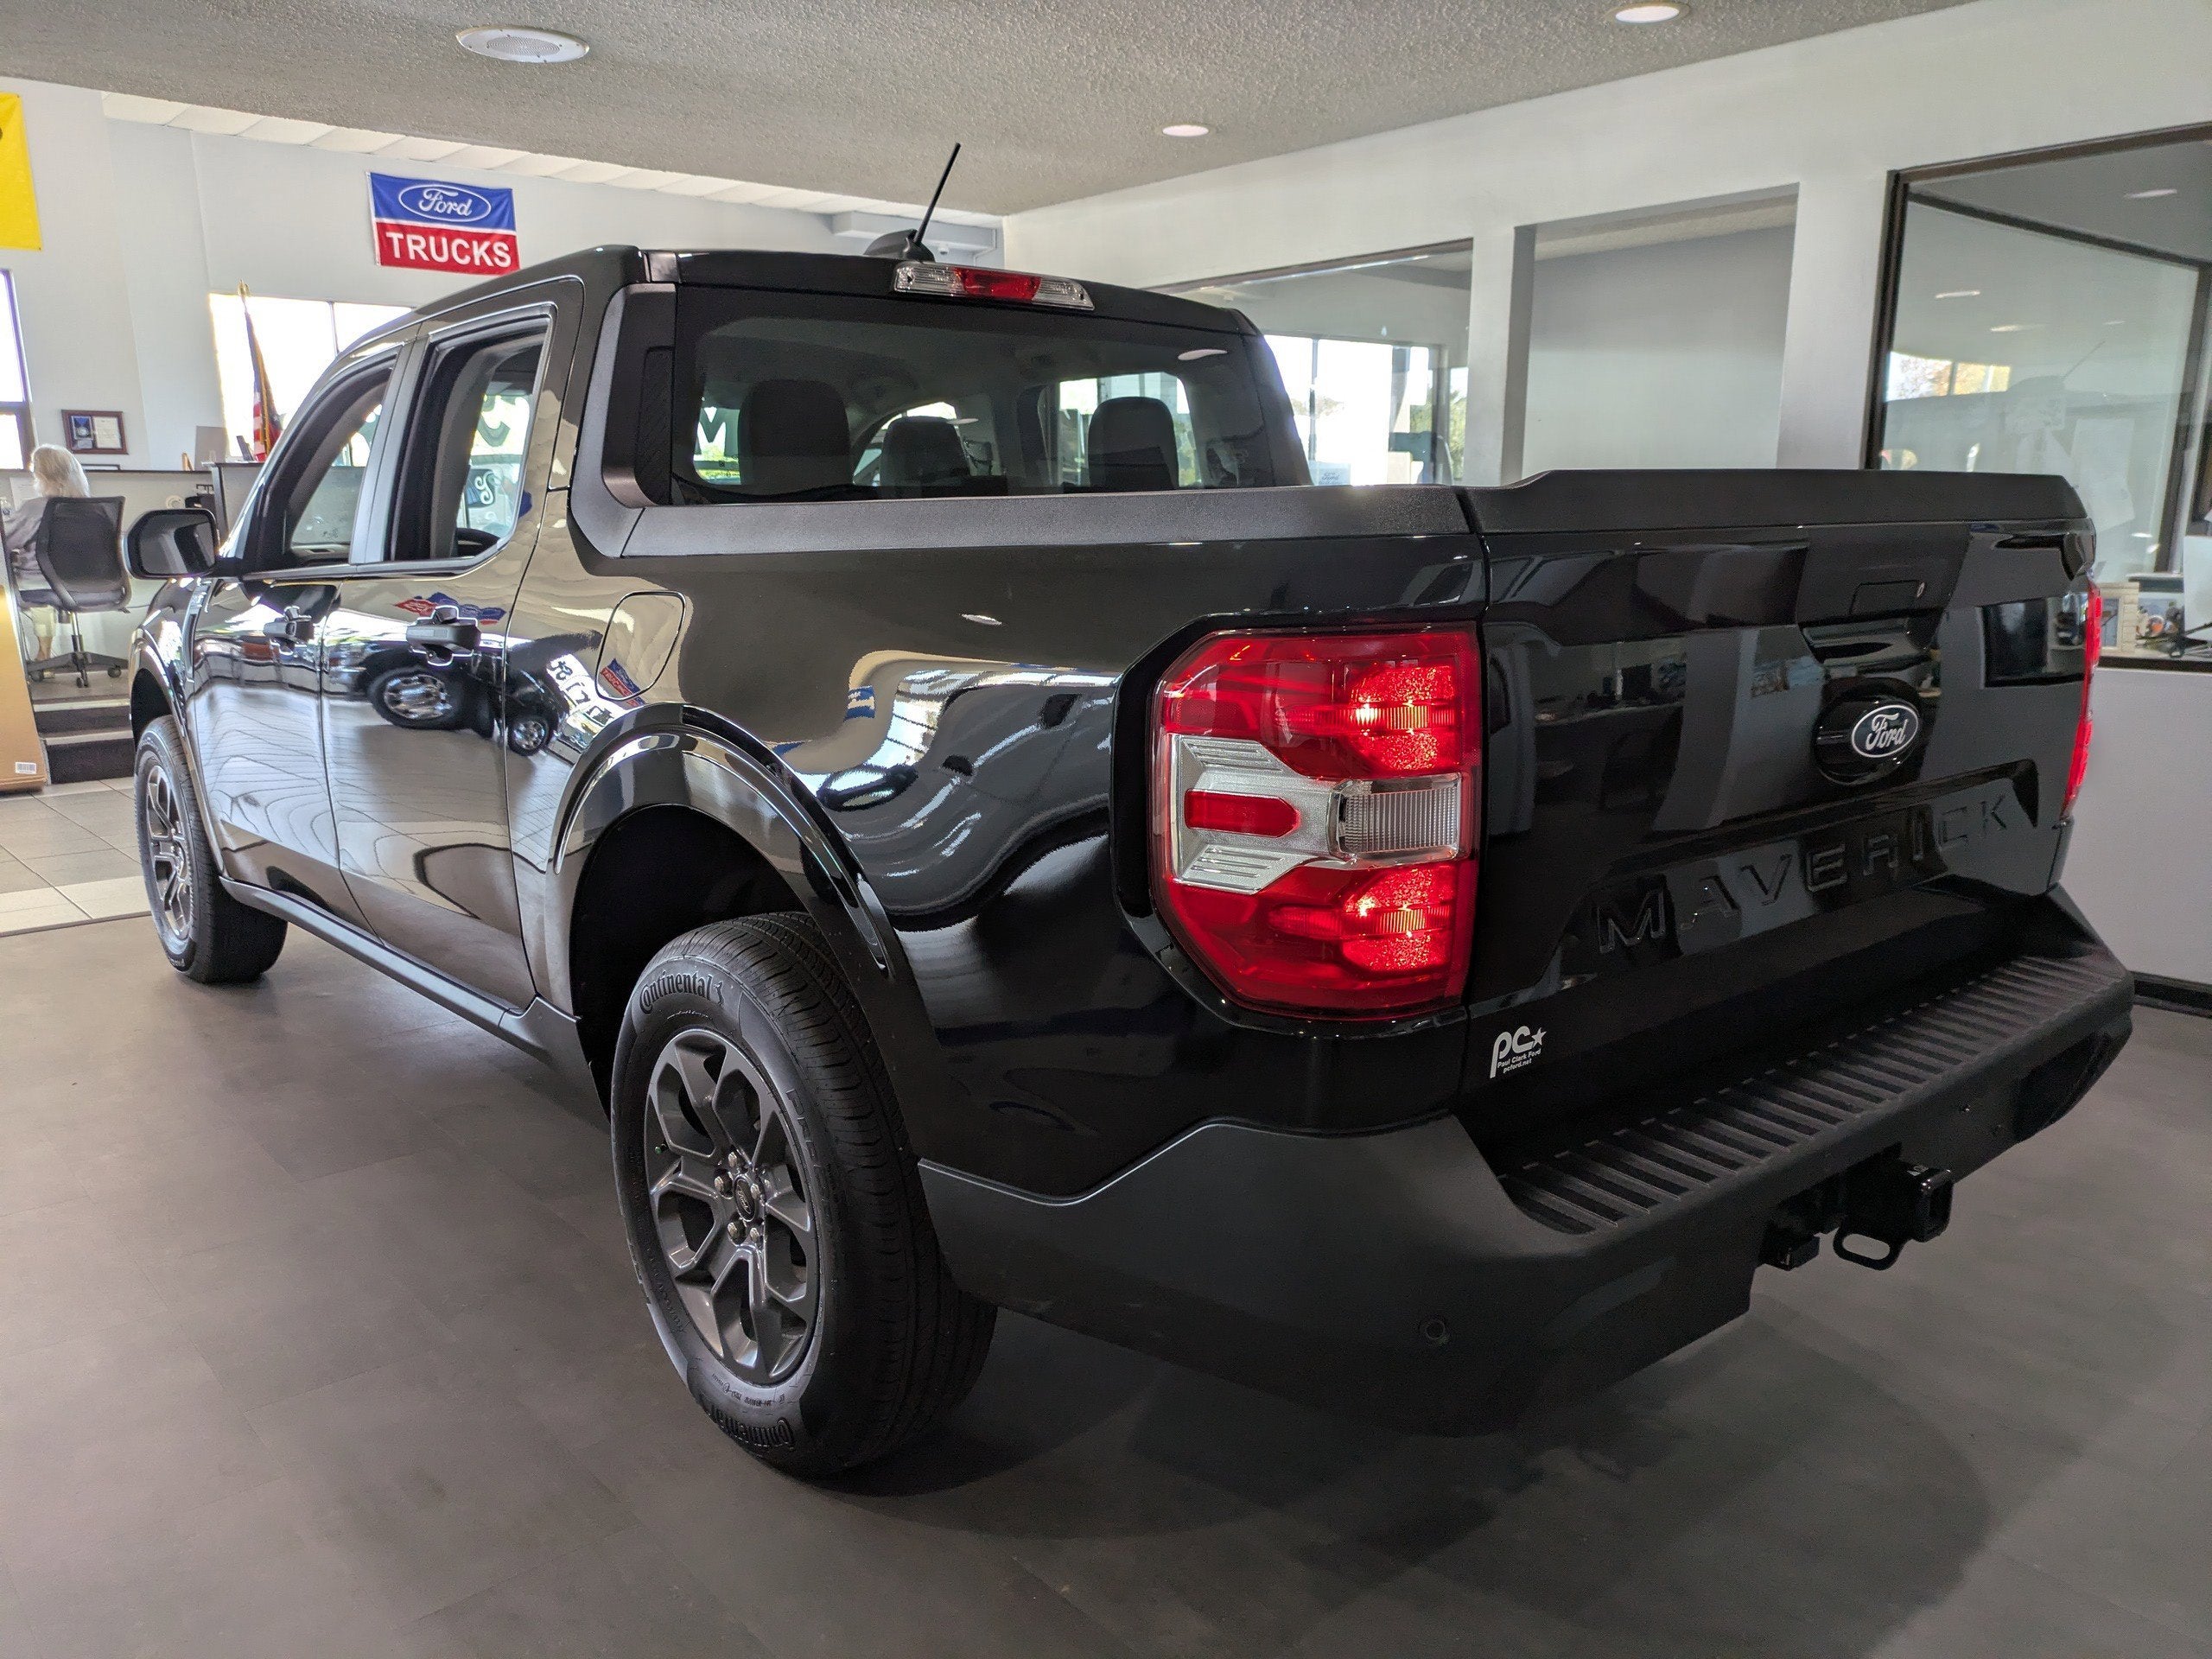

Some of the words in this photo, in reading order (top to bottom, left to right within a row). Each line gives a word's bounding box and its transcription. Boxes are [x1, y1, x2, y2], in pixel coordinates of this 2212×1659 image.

[416, 188, 473, 217] Ford
[385, 231, 512, 268] TRUCKS
[1866, 712, 1909, 751] Ford
[1595, 792, 2008, 954] MAVERICK
[639, 969, 714, 1014] Continental
[1497, 1058, 1510, 1069] Paul
[1511, 1052, 1528, 1064] Clark
[1529, 1047, 1541, 1058] Ford
[1503, 1058, 1532, 1074] pcford.net
